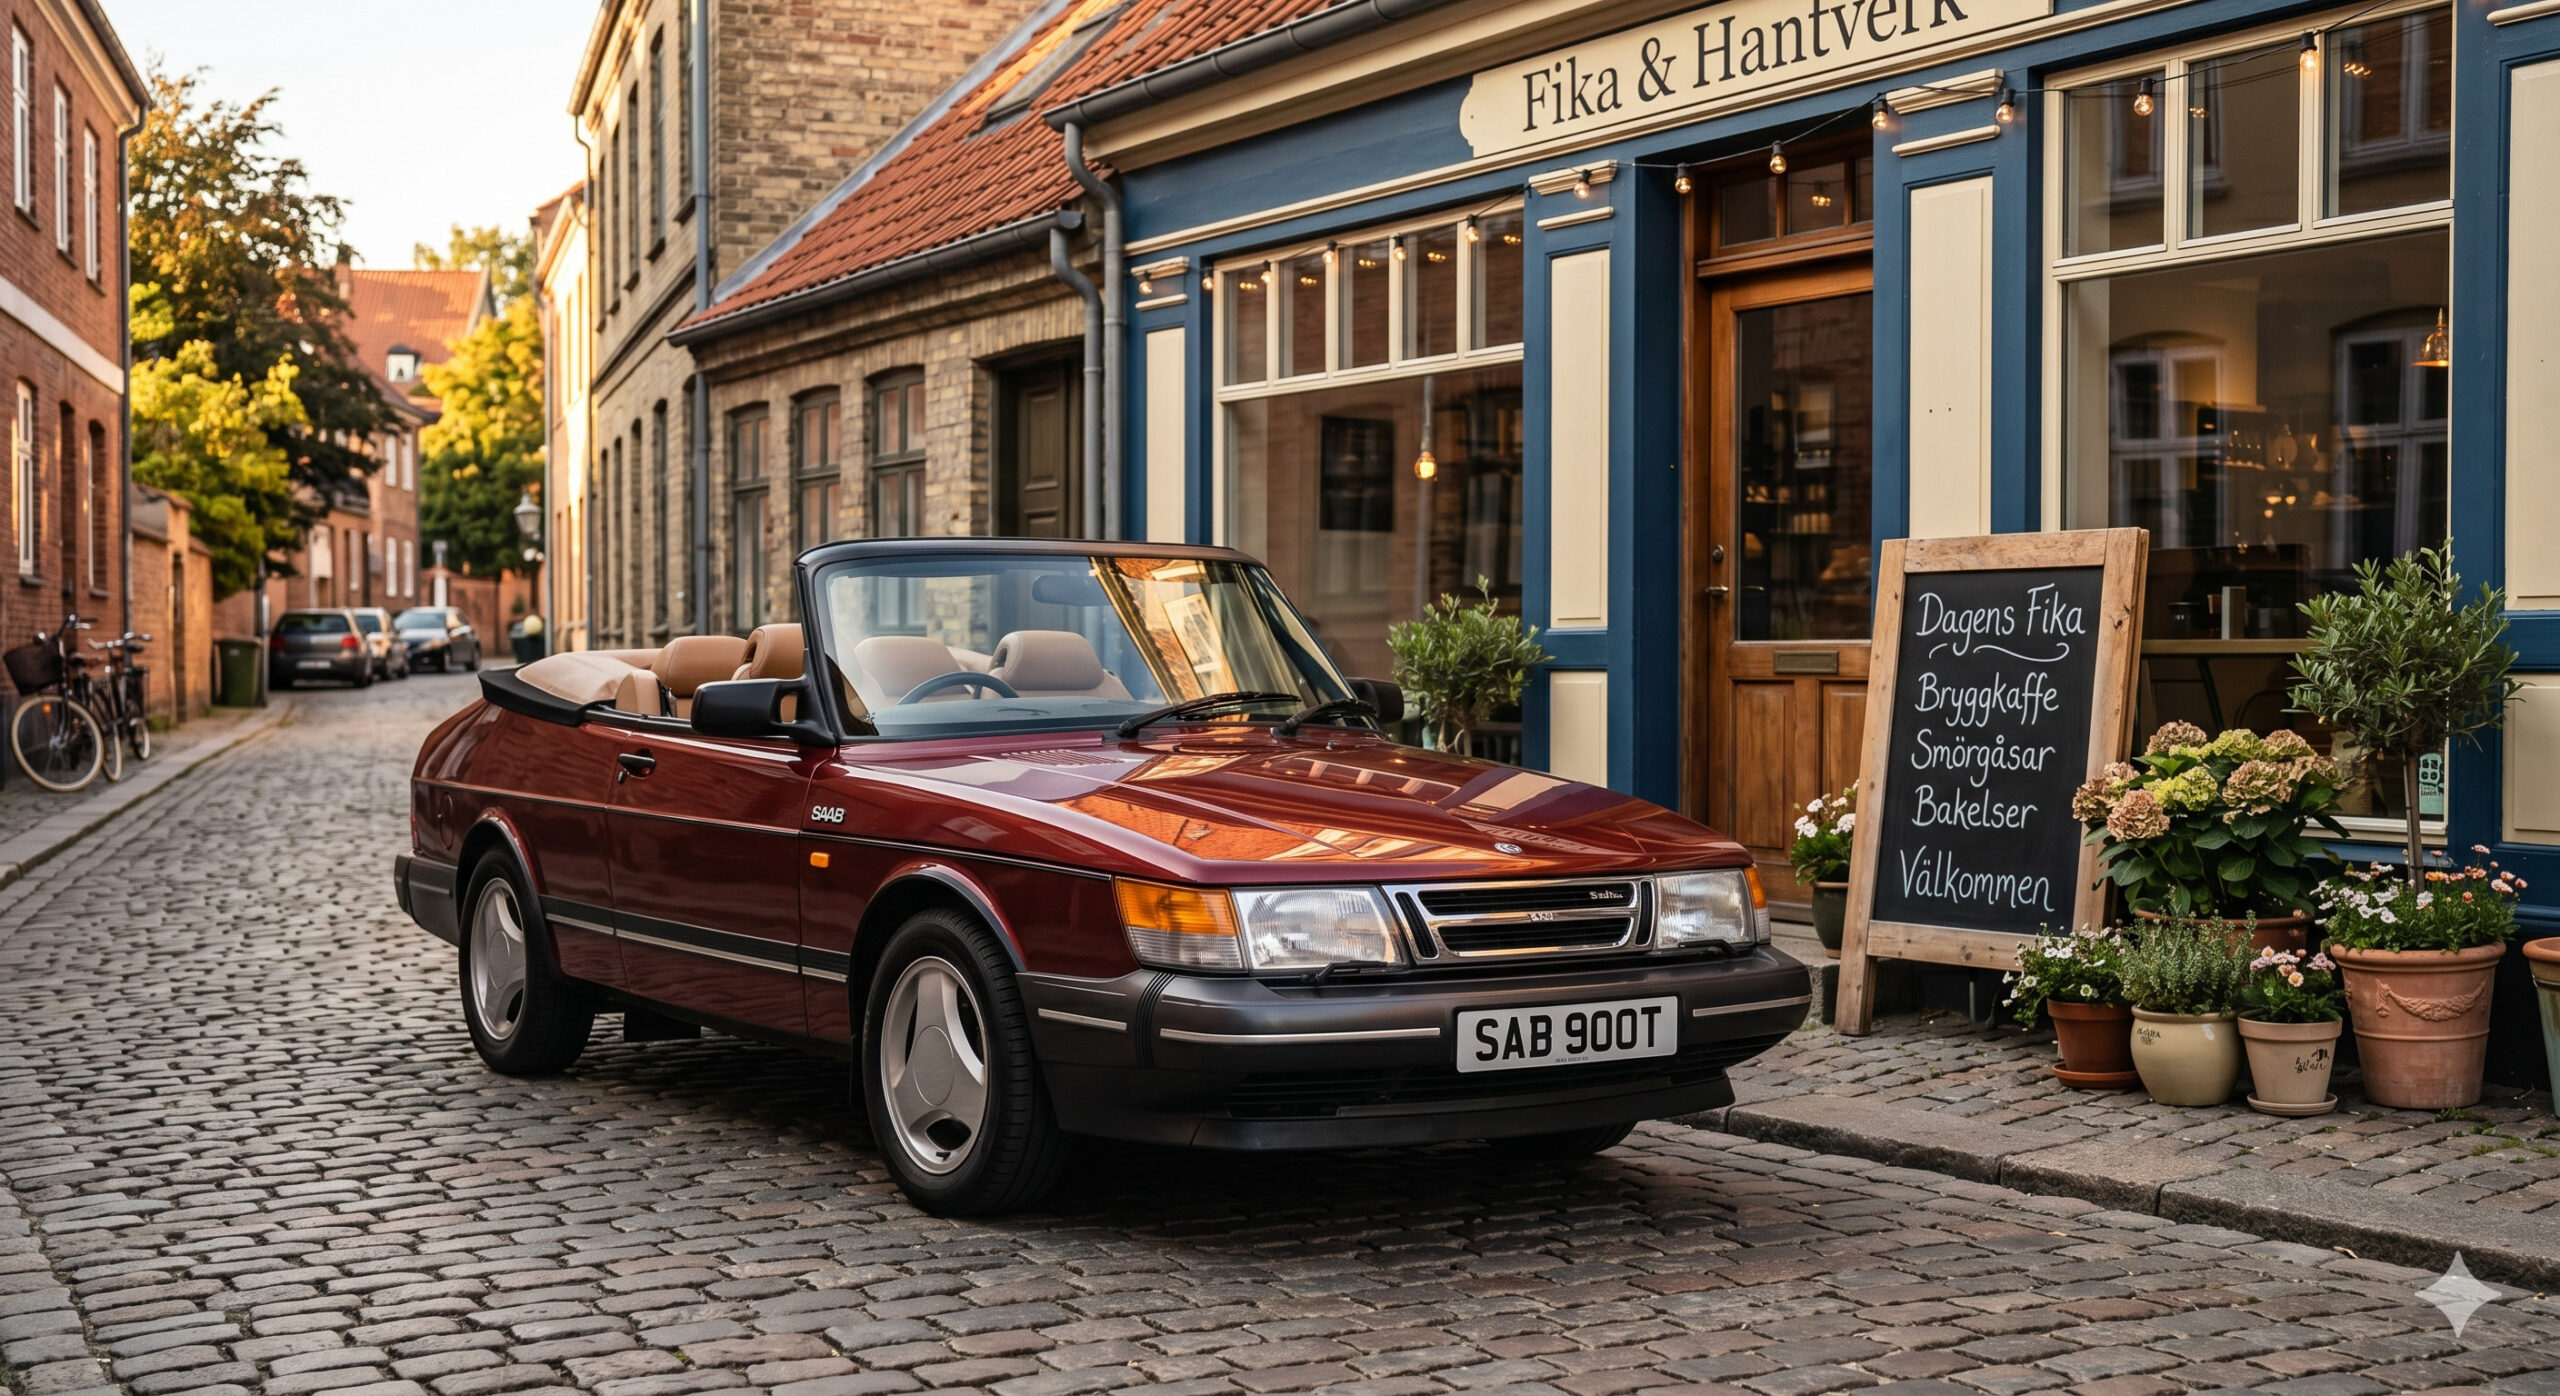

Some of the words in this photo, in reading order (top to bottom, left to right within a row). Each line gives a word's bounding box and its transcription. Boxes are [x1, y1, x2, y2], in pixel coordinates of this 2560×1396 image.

[1523, 56, 1623, 132] Fika
[1638, 37, 1677, 102] &
[1916, 592, 2016, 656] Dagens
[2027, 583, 2086, 636] Fika
[1915, 672, 2060, 727] Bryggkaffe
[1911, 728, 2056, 788] Smörgåsar
[811, 805, 845, 823] SAAB
[1911, 784, 2039, 830] Bakelser
[1900, 845, 2055, 912] Välkommen
[1475, 1015, 1553, 1062] SAB
[1565, 1005, 1662, 1055] 900T
